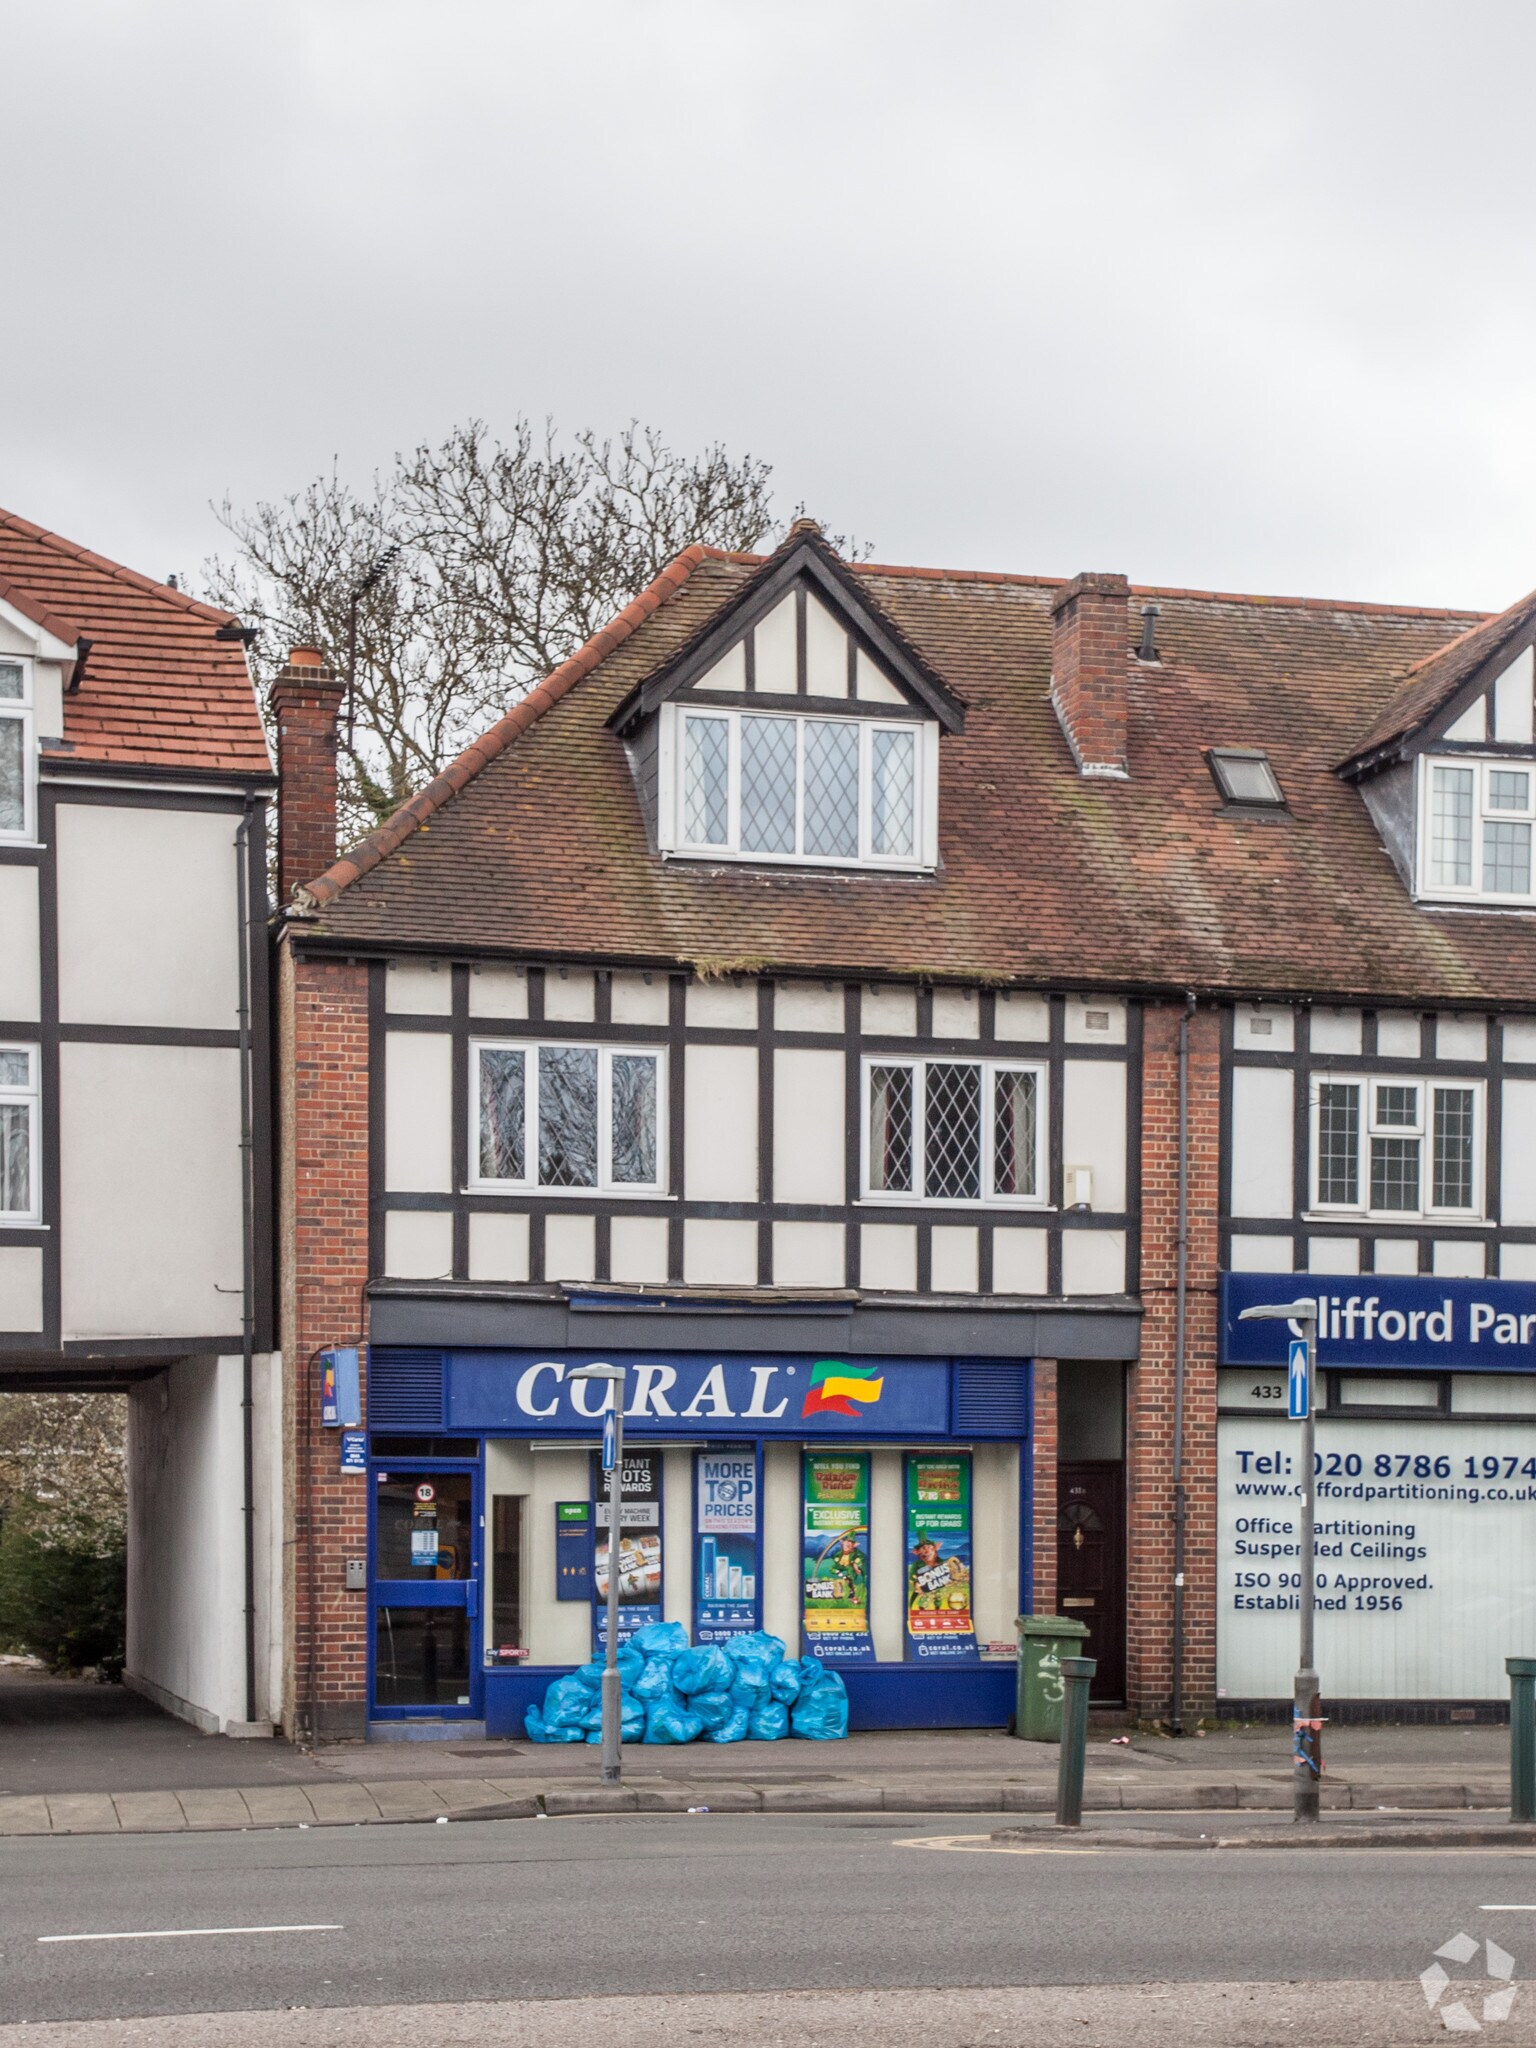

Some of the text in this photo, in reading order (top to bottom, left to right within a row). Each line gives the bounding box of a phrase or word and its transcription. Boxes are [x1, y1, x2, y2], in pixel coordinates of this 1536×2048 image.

[516, 1362, 788, 1418] CORAL
[1251, 1386, 1283, 1399] 433
[705, 1463, 753, 1478] MORE
[1235, 1451, 1292, 1474] Tel:
[1374, 1454, 1451, 1478] 8786
[1464, 1456, 1536, 1479] 1974
[604, 1470, 651, 1482] SOTS
[420, 1488, 431, 1497] 18
[604, 1483, 652, 1492] RWARDS
[705, 1480, 753, 1502] TOP
[1236, 1482, 1536, 1503] www.cffordpartitioning.co.uk
[705, 1504, 753, 1516] PRICES
[813, 1510, 861, 1520] EXCLUSIVE
[1235, 1518, 1415, 1540] Office artitioning
[1350, 1542, 1427, 1561] Ceilings
[918, 1562, 951, 1585] BONUS
[806, 1581, 834, 1592] BONUS
[927, 1573, 953, 1591] BANK
[1234, 1573, 1433, 1592] ISO 900 Approved.
[812, 1590, 834, 1599] BANK
[1234, 1595, 1403, 1611] Establihed 1956
